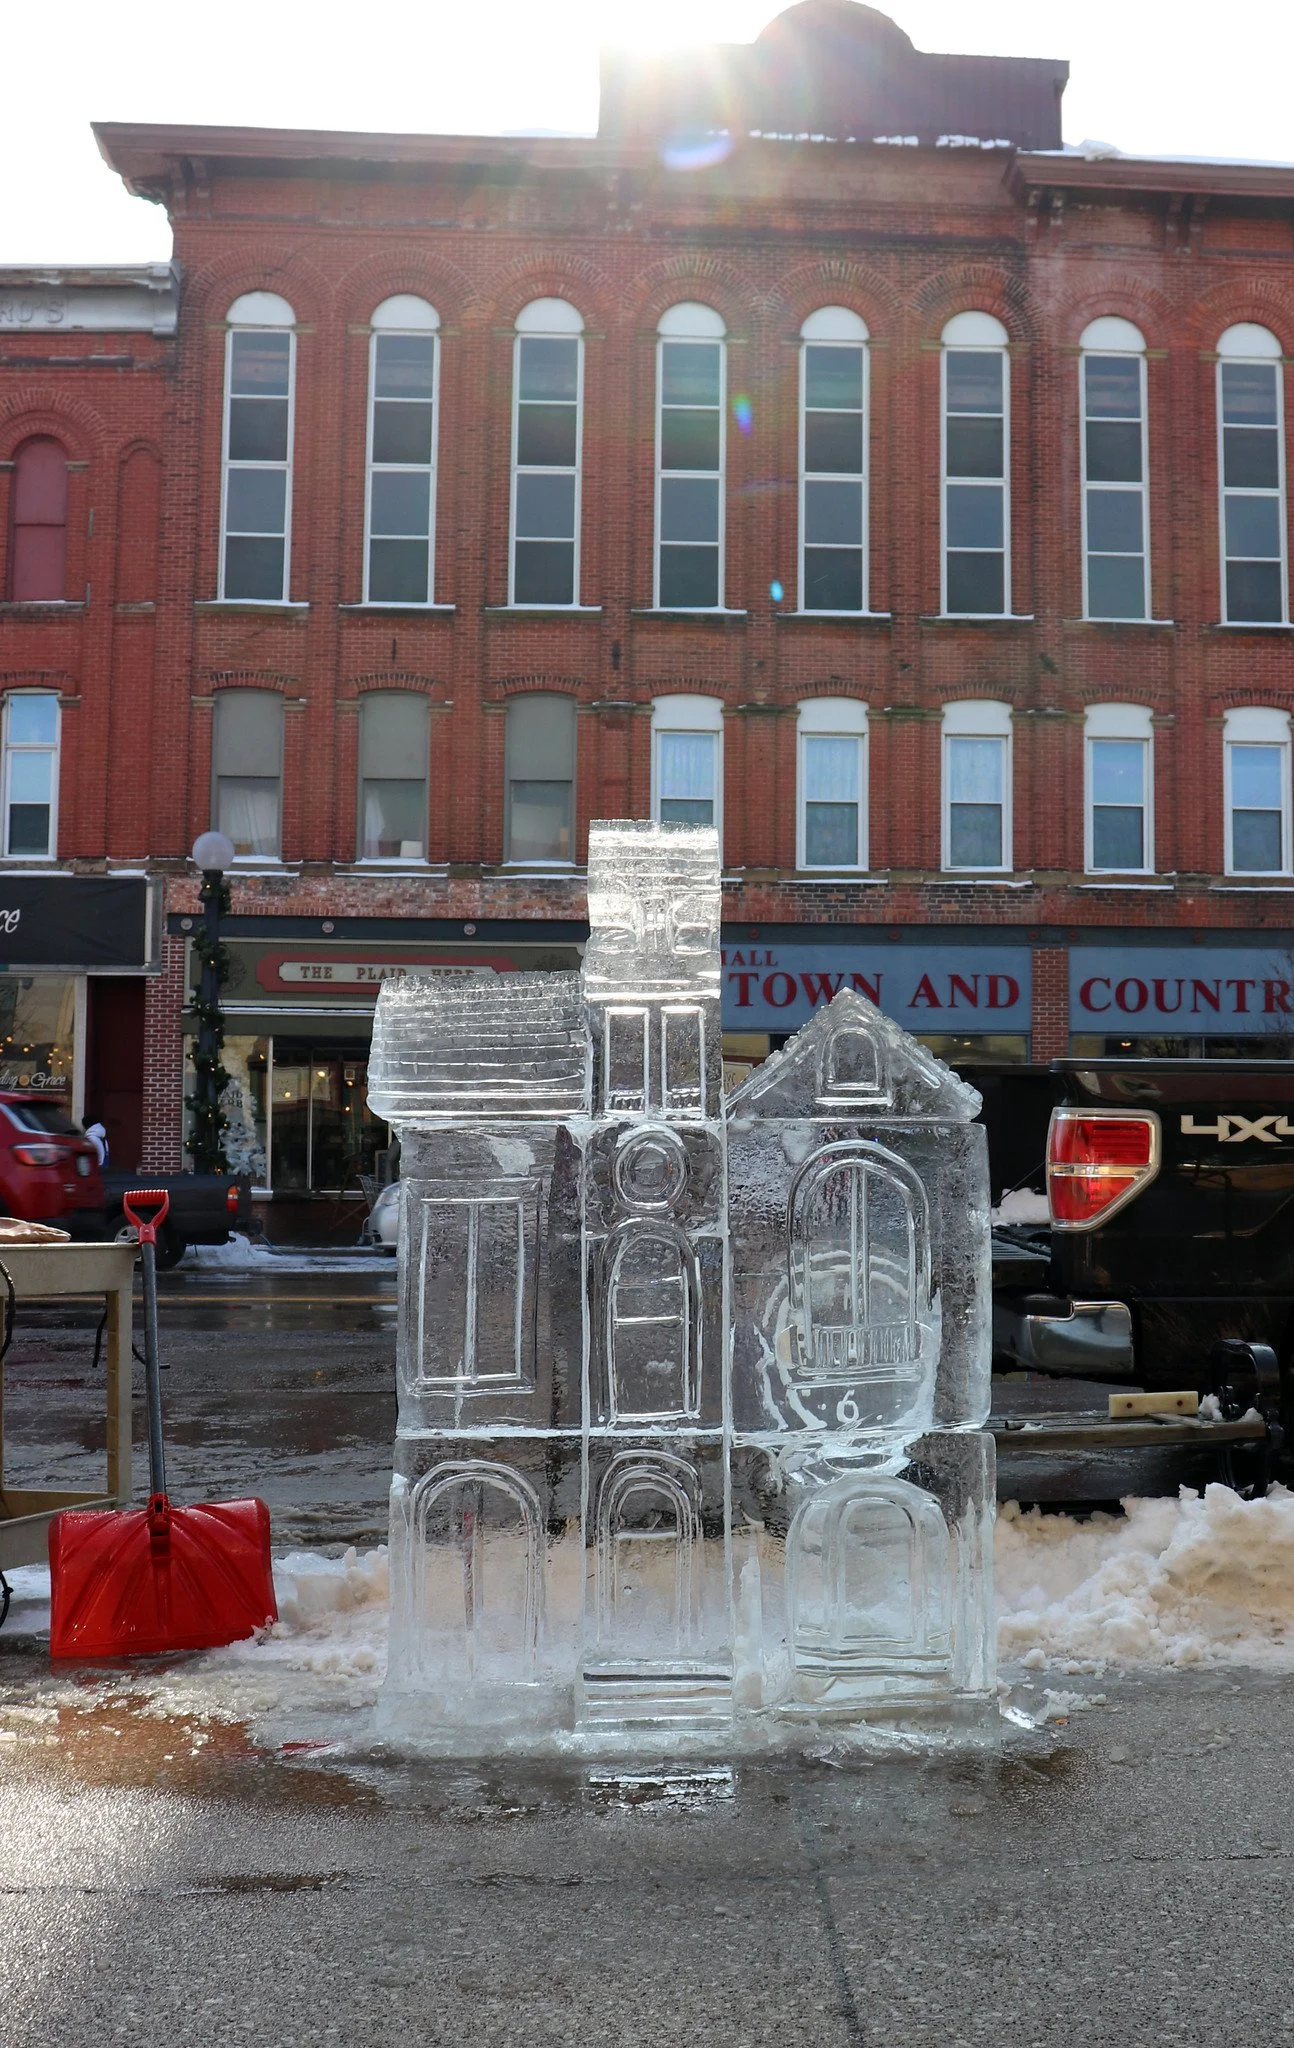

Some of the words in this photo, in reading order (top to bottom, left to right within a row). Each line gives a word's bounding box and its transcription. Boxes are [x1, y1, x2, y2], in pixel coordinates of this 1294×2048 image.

[300, 966, 333, 979] THE
[356, 967, 407, 980] PLAID
[728, 972, 884, 1008] TOWN
[907, 973, 1020, 1009] AND
[1079, 977, 1294, 1013] COUNTR
[30, 1072, 66, 1088] Grace
